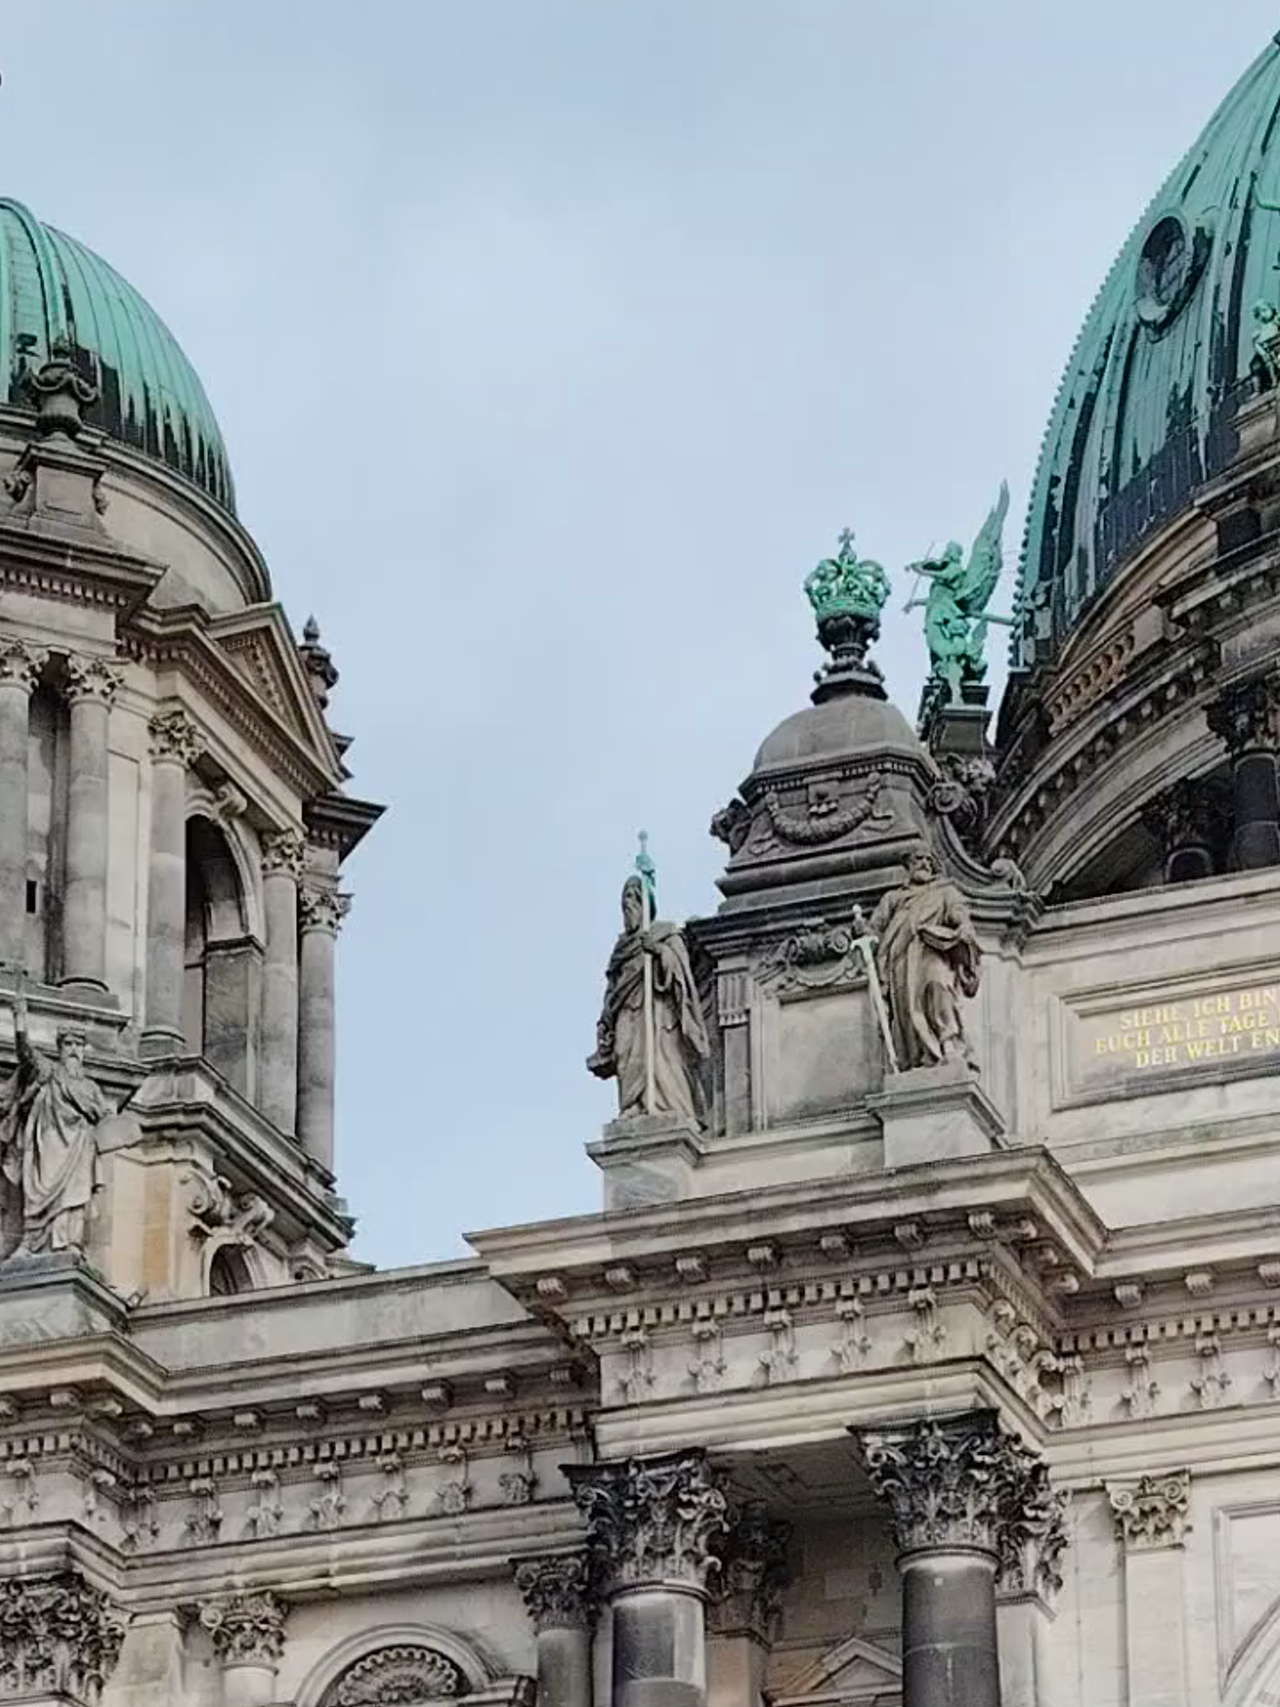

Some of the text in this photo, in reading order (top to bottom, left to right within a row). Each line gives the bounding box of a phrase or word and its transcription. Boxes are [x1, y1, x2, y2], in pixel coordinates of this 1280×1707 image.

[1194, 995, 1231, 1018] ICH
[1240, 987, 1277, 1011] BIN
[1095, 1028, 1151, 1055] EUCH
[1160, 1019, 1210, 1045] ALLE
[1221, 1010, 1271, 1035] TAGE
[1136, 1046, 1178, 1069] DER
[1186, 1035, 1242, 1061] WELT
